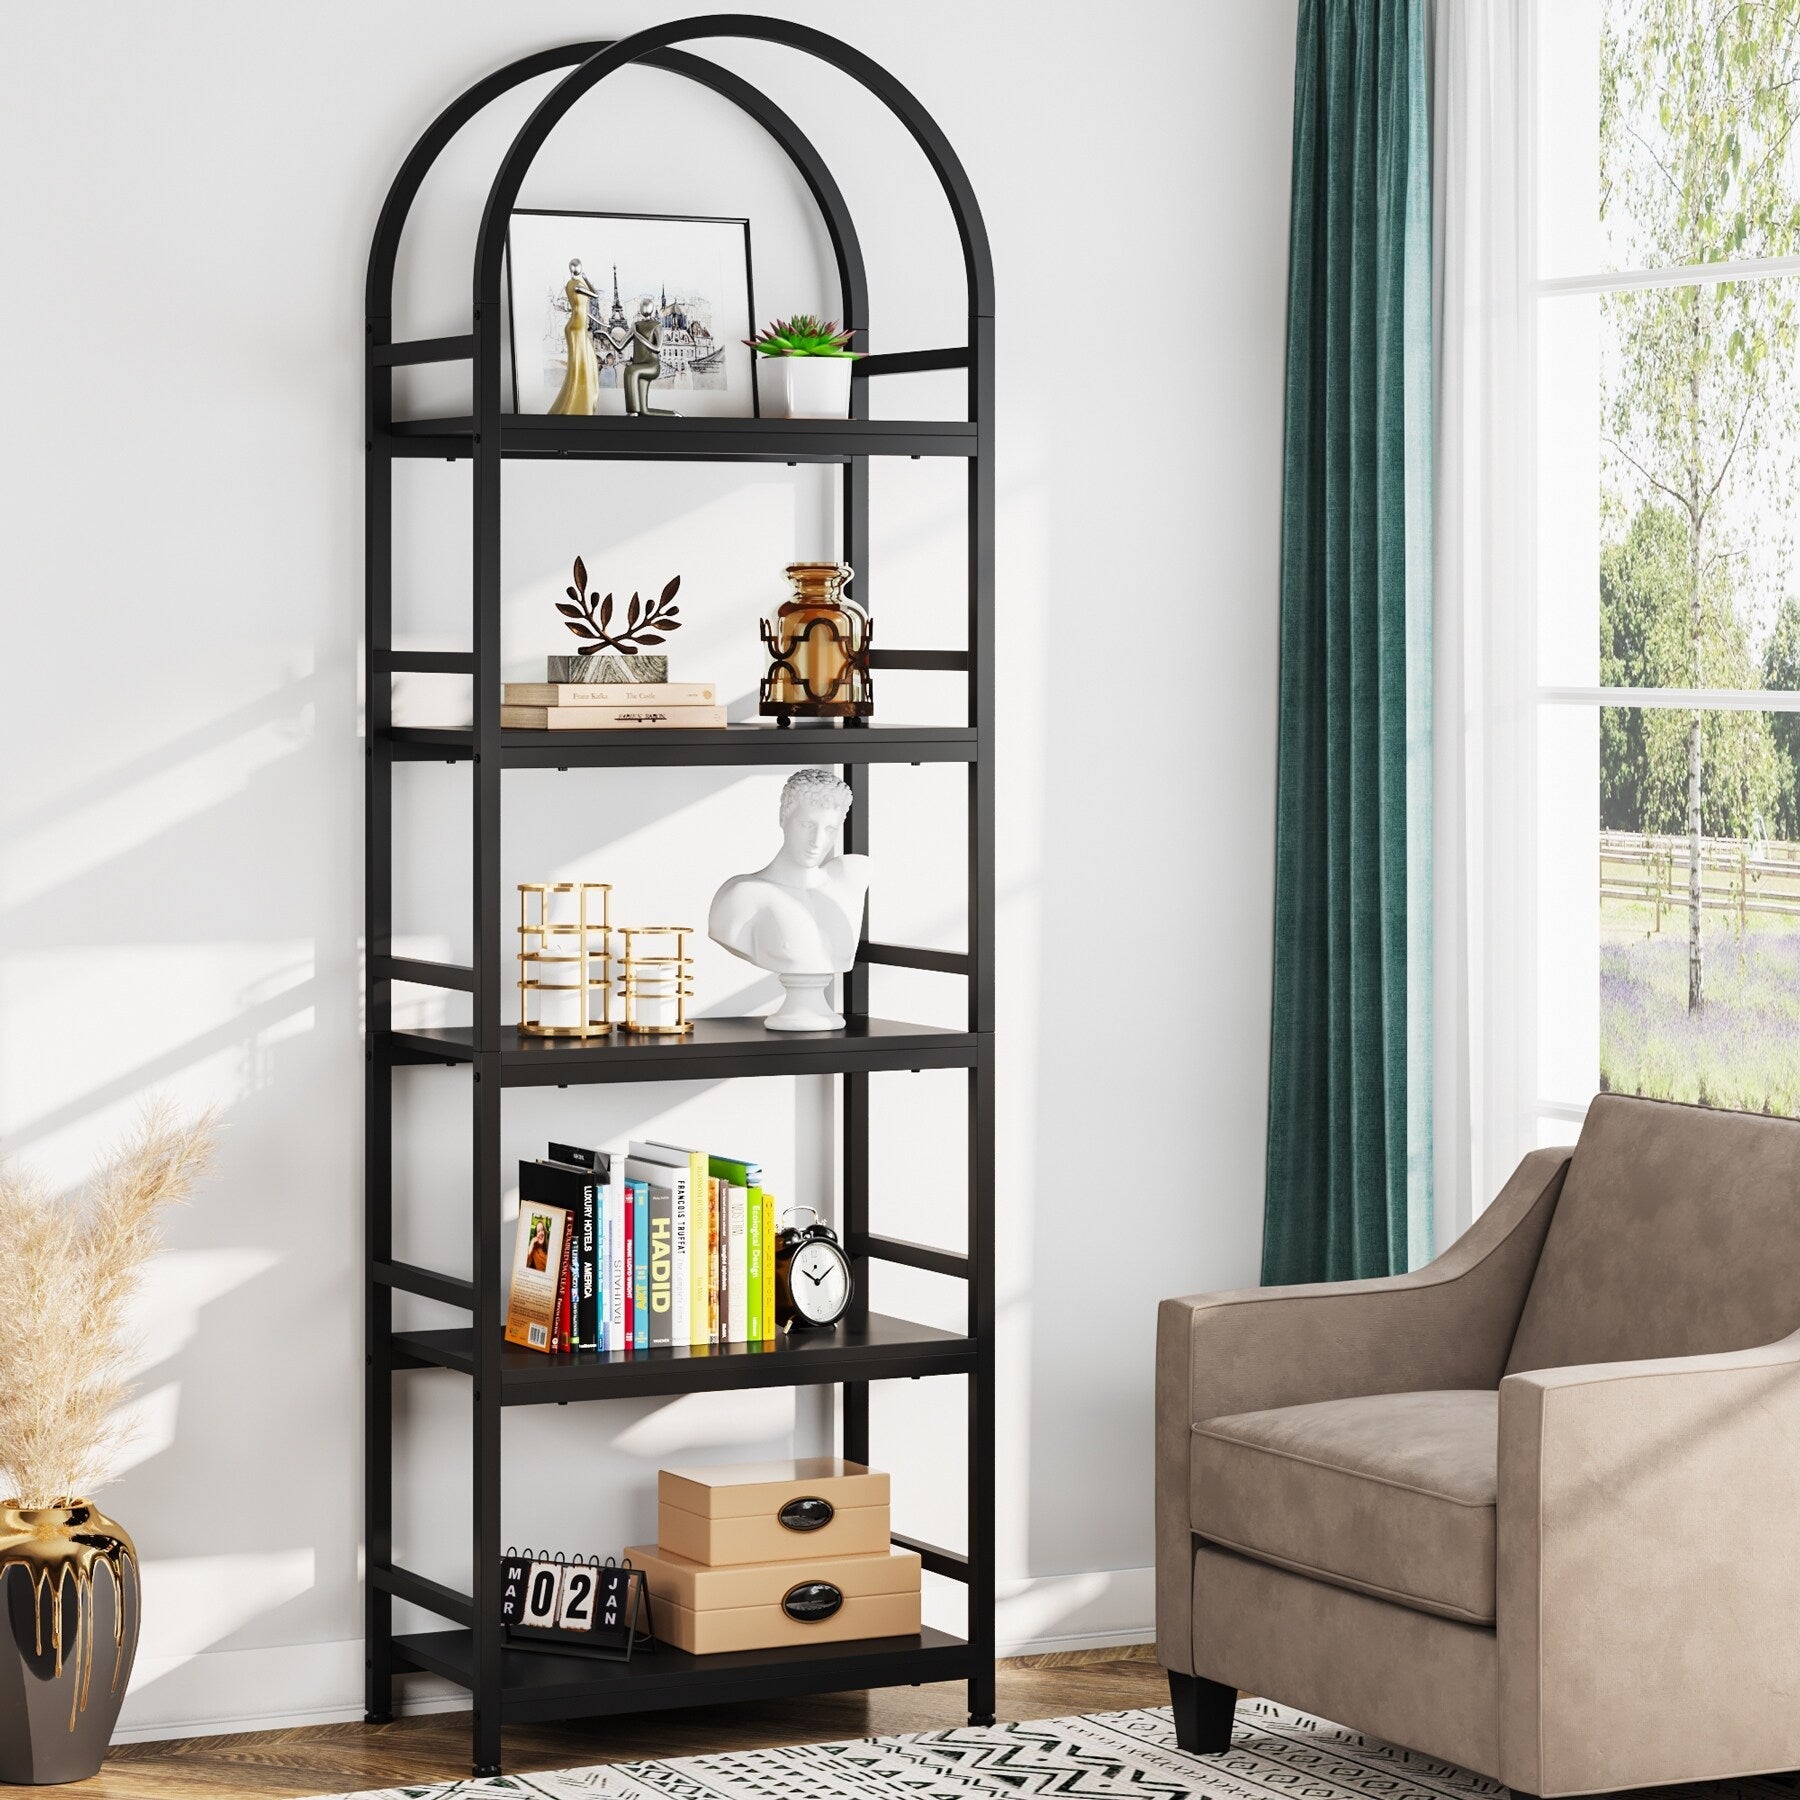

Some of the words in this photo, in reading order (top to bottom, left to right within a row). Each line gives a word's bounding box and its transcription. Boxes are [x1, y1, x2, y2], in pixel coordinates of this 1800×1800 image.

[591, 692, 608, 700] Kafka
[625, 692, 638, 700] The
[583, 1184, 593, 1218] LUXURY
[583, 1219, 593, 1252] HOTELS
[750, 1205, 761, 1246] Ecological
[583, 1262, 593, 1299] AMERICA
[651, 1217, 671, 1313] HADID
[750, 1249, 761, 1278] Design
[559, 1277, 567, 1295] LEAF
[614, 1260, 622, 1325] BAUHAUS
[503, 1567, 522, 1615] MAR
[604, 1577, 618, 1625] JAN
